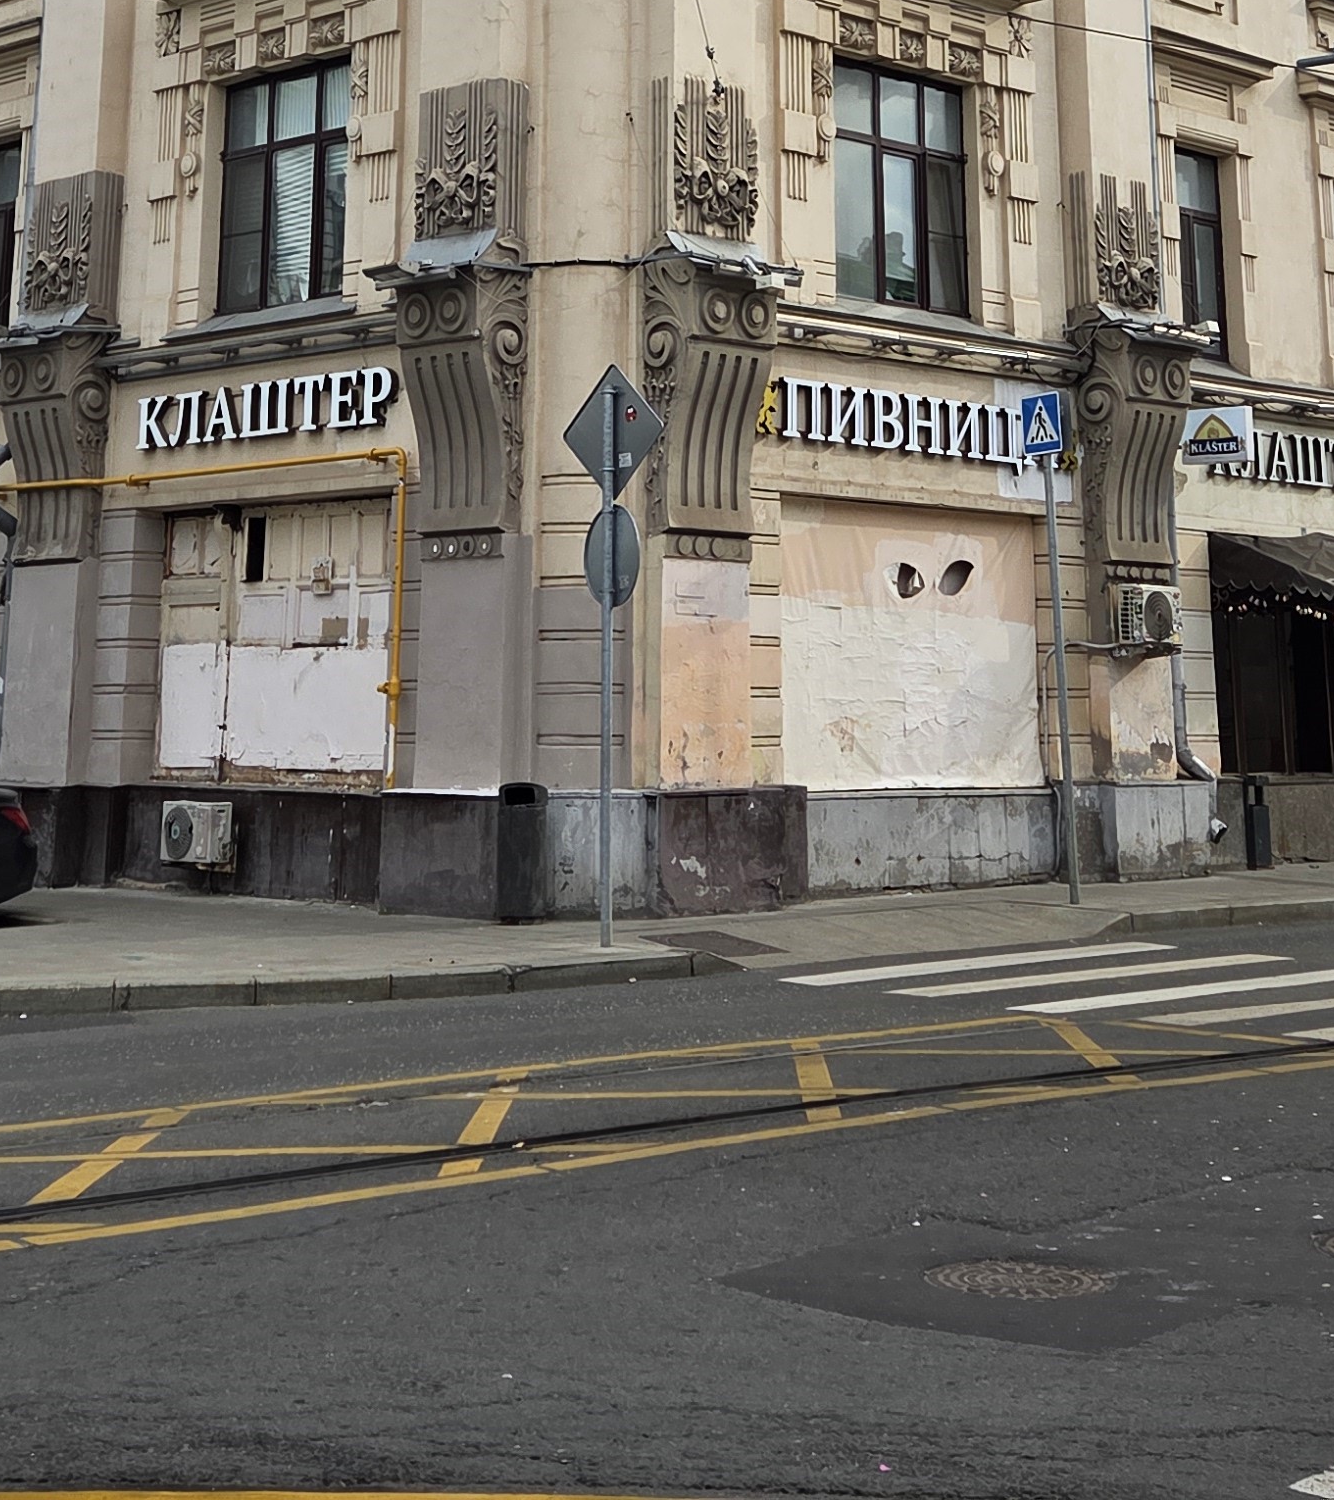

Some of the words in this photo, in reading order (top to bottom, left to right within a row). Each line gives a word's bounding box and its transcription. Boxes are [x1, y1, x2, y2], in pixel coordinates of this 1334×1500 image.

[136, 366, 399, 449] КЛАШТЕР
[781, 376, 1060, 477] ПИВНИЦ
[1190, 440, 1237, 454] KLÁŠTER
